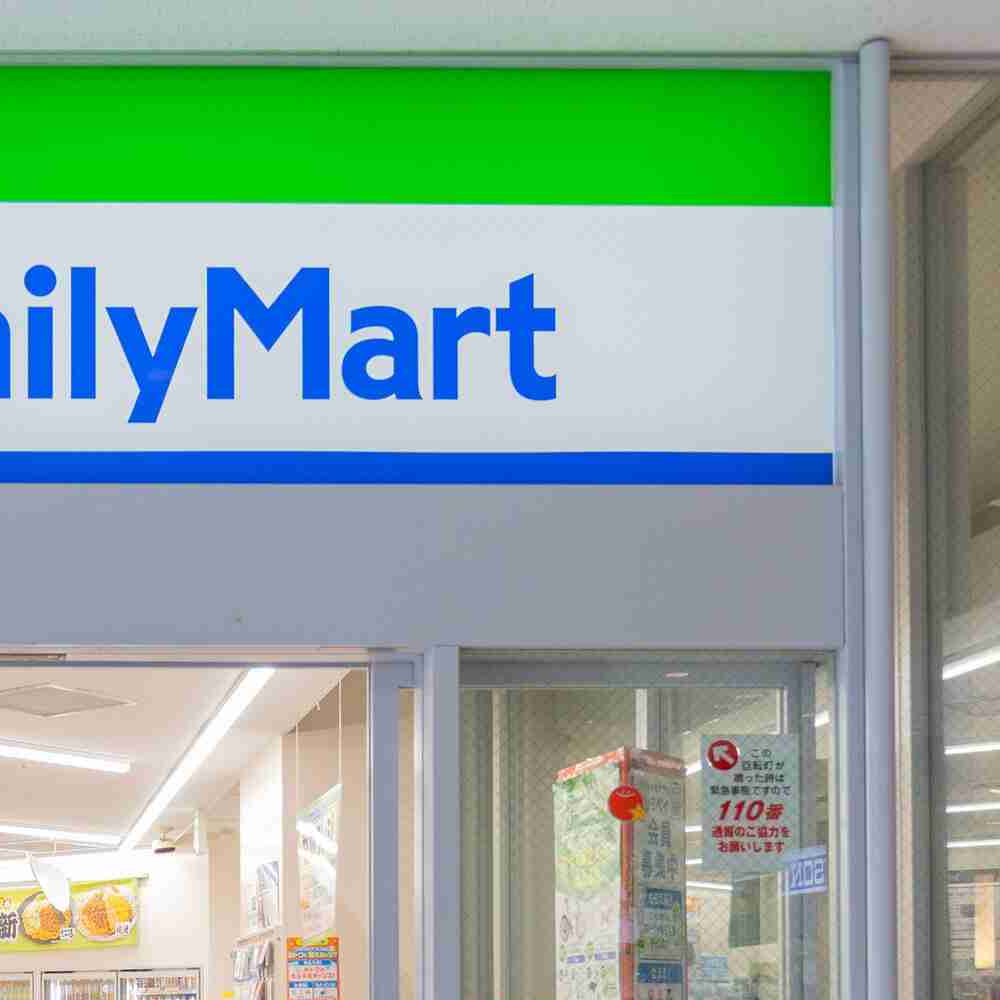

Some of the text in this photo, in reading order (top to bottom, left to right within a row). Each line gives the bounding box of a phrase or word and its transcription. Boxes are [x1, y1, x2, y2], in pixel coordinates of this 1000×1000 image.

[719, 799, 785, 821] 110番
[711, 825, 792, 838] 通報のご協力を
[717, 841, 785, 854] お願いします
